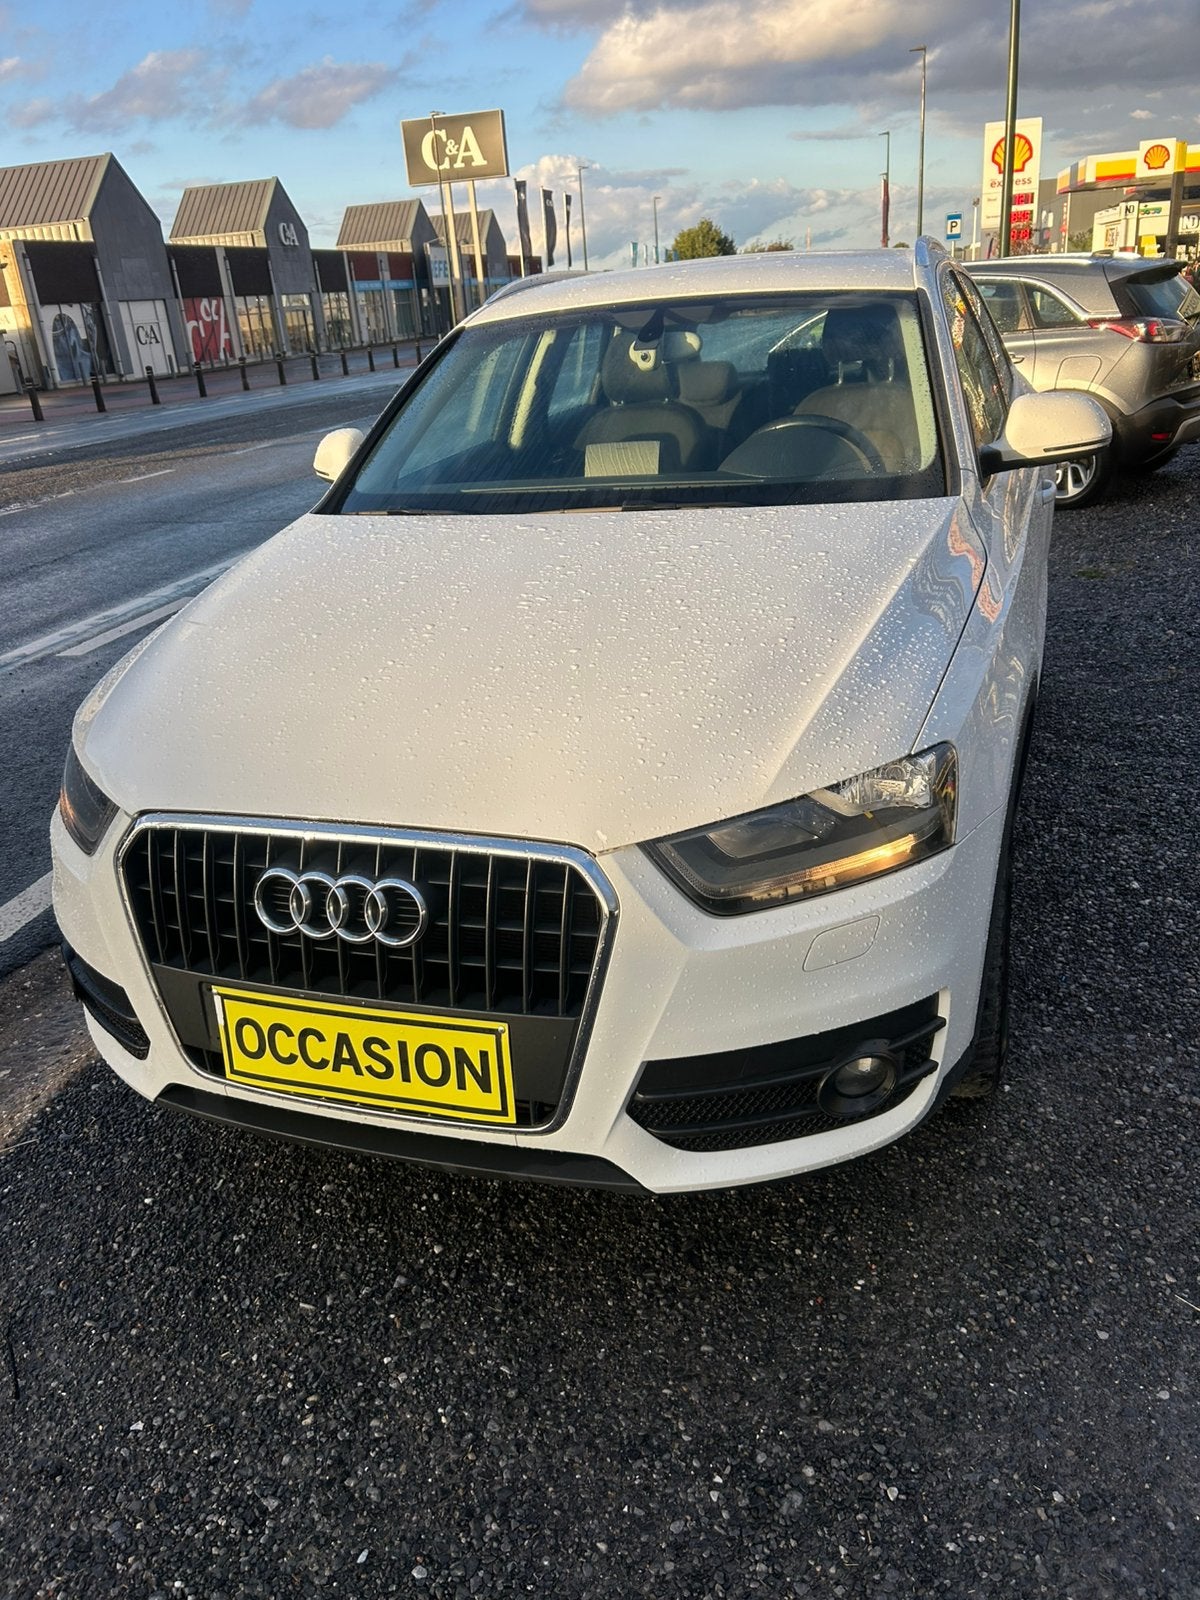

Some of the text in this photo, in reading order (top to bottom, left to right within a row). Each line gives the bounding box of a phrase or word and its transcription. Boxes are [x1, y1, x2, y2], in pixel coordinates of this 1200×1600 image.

[422, 126, 488, 170] C&A
[990, 177, 1032, 188] exess
[279, 222, 300, 246] C&A
[950, 221, 958, 233] P
[136, 324, 161, 345] C&A
[235, 1017, 492, 1094] OCCASION
